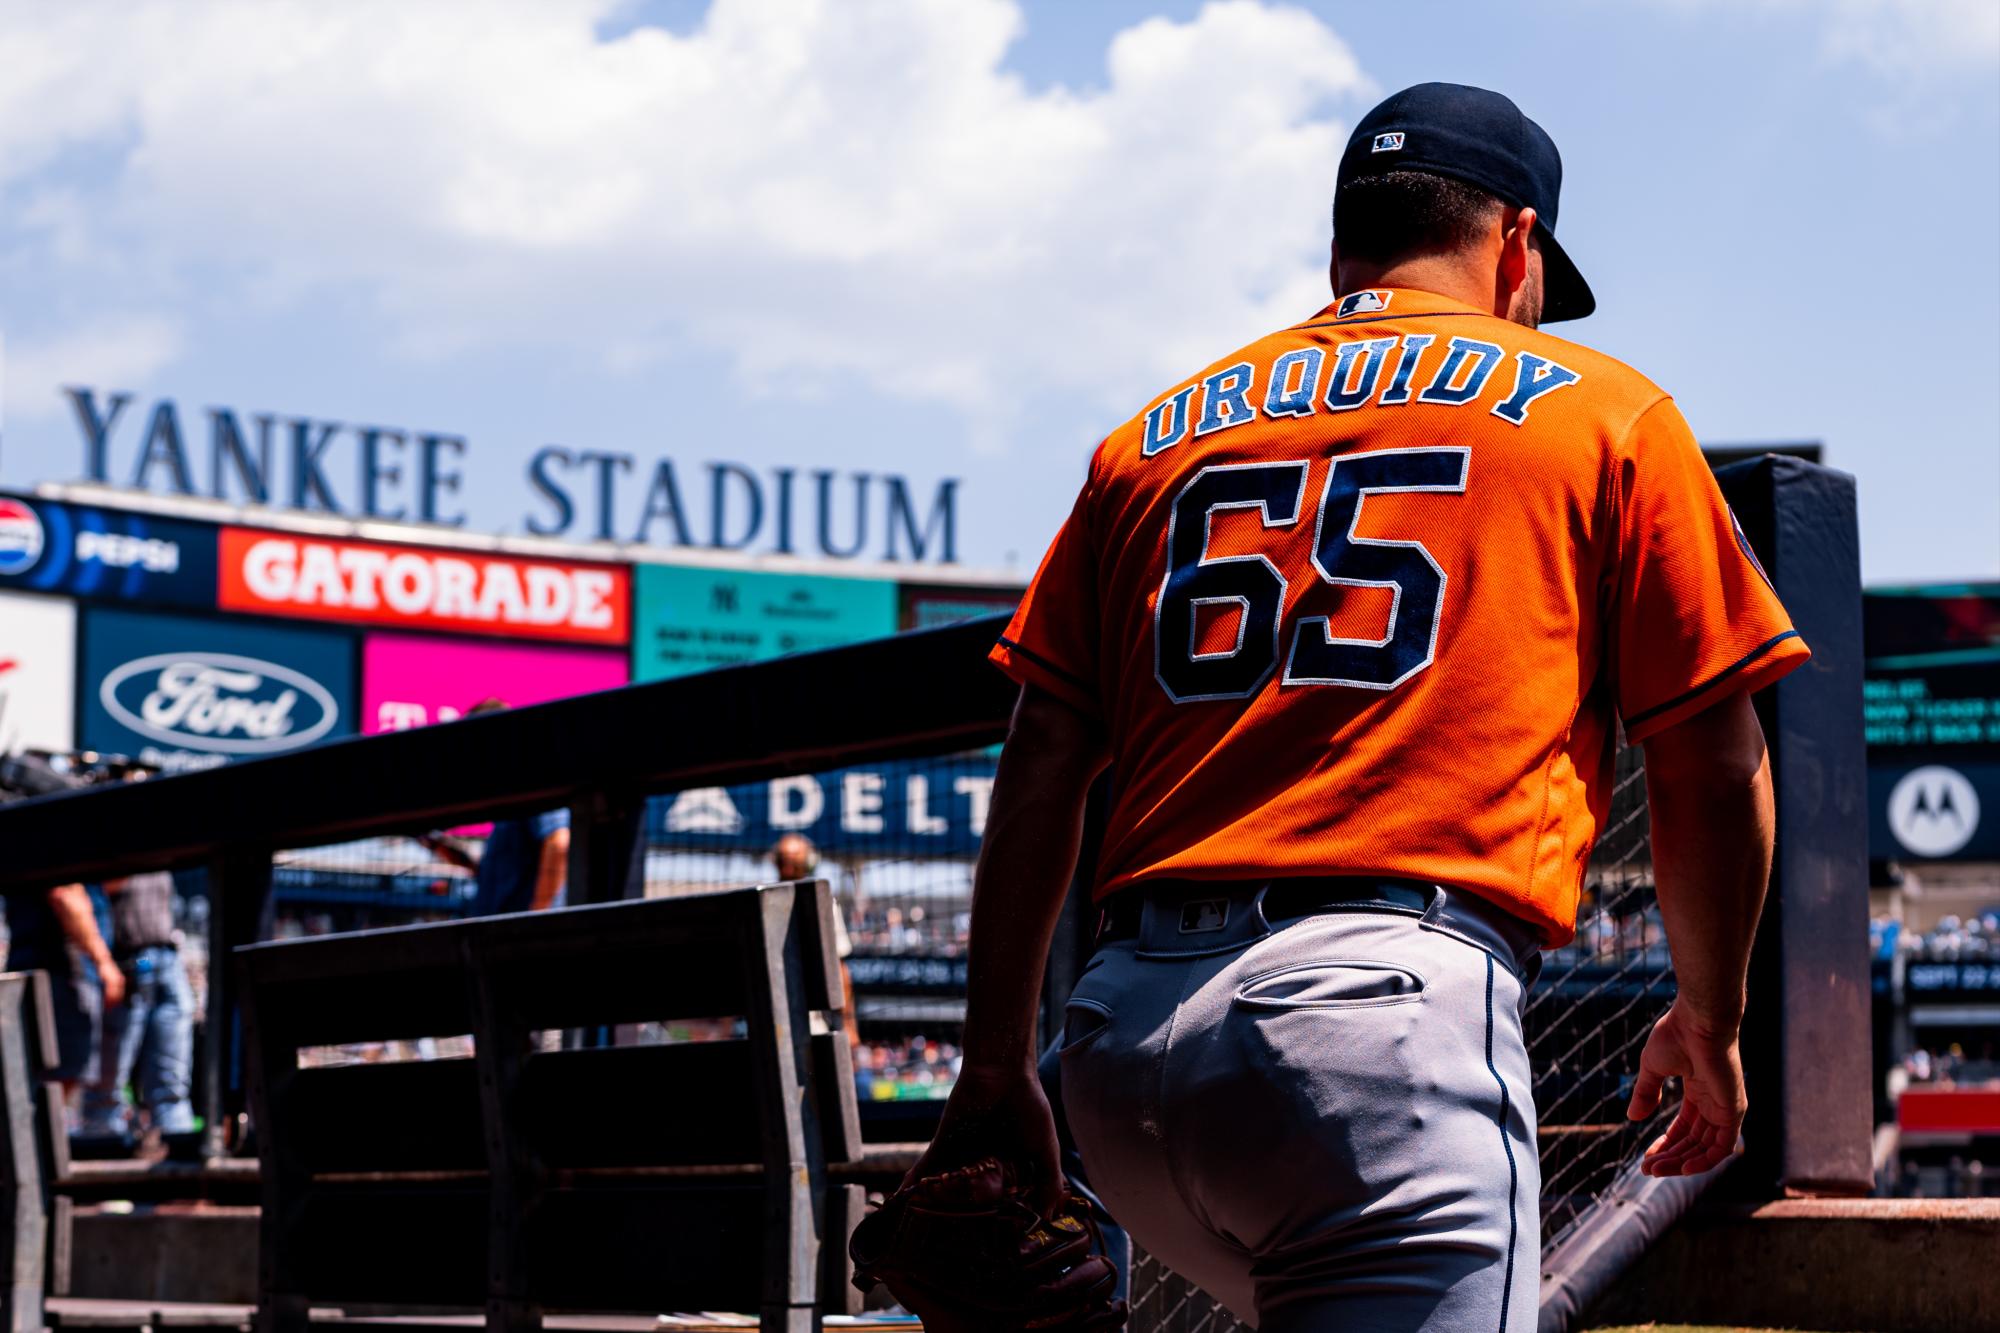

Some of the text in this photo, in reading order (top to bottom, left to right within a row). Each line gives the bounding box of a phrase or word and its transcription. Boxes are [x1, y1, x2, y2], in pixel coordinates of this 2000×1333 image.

[1142, 334, 1582, 457] URQUIDY
[64, 385, 965, 565] YANKEE STADIUM
[243, 540, 614, 630] GATORADE
[1154, 446, 1473, 704] 65
[141, 662, 298, 738] Ford
[767, 773, 995, 837] DELT
